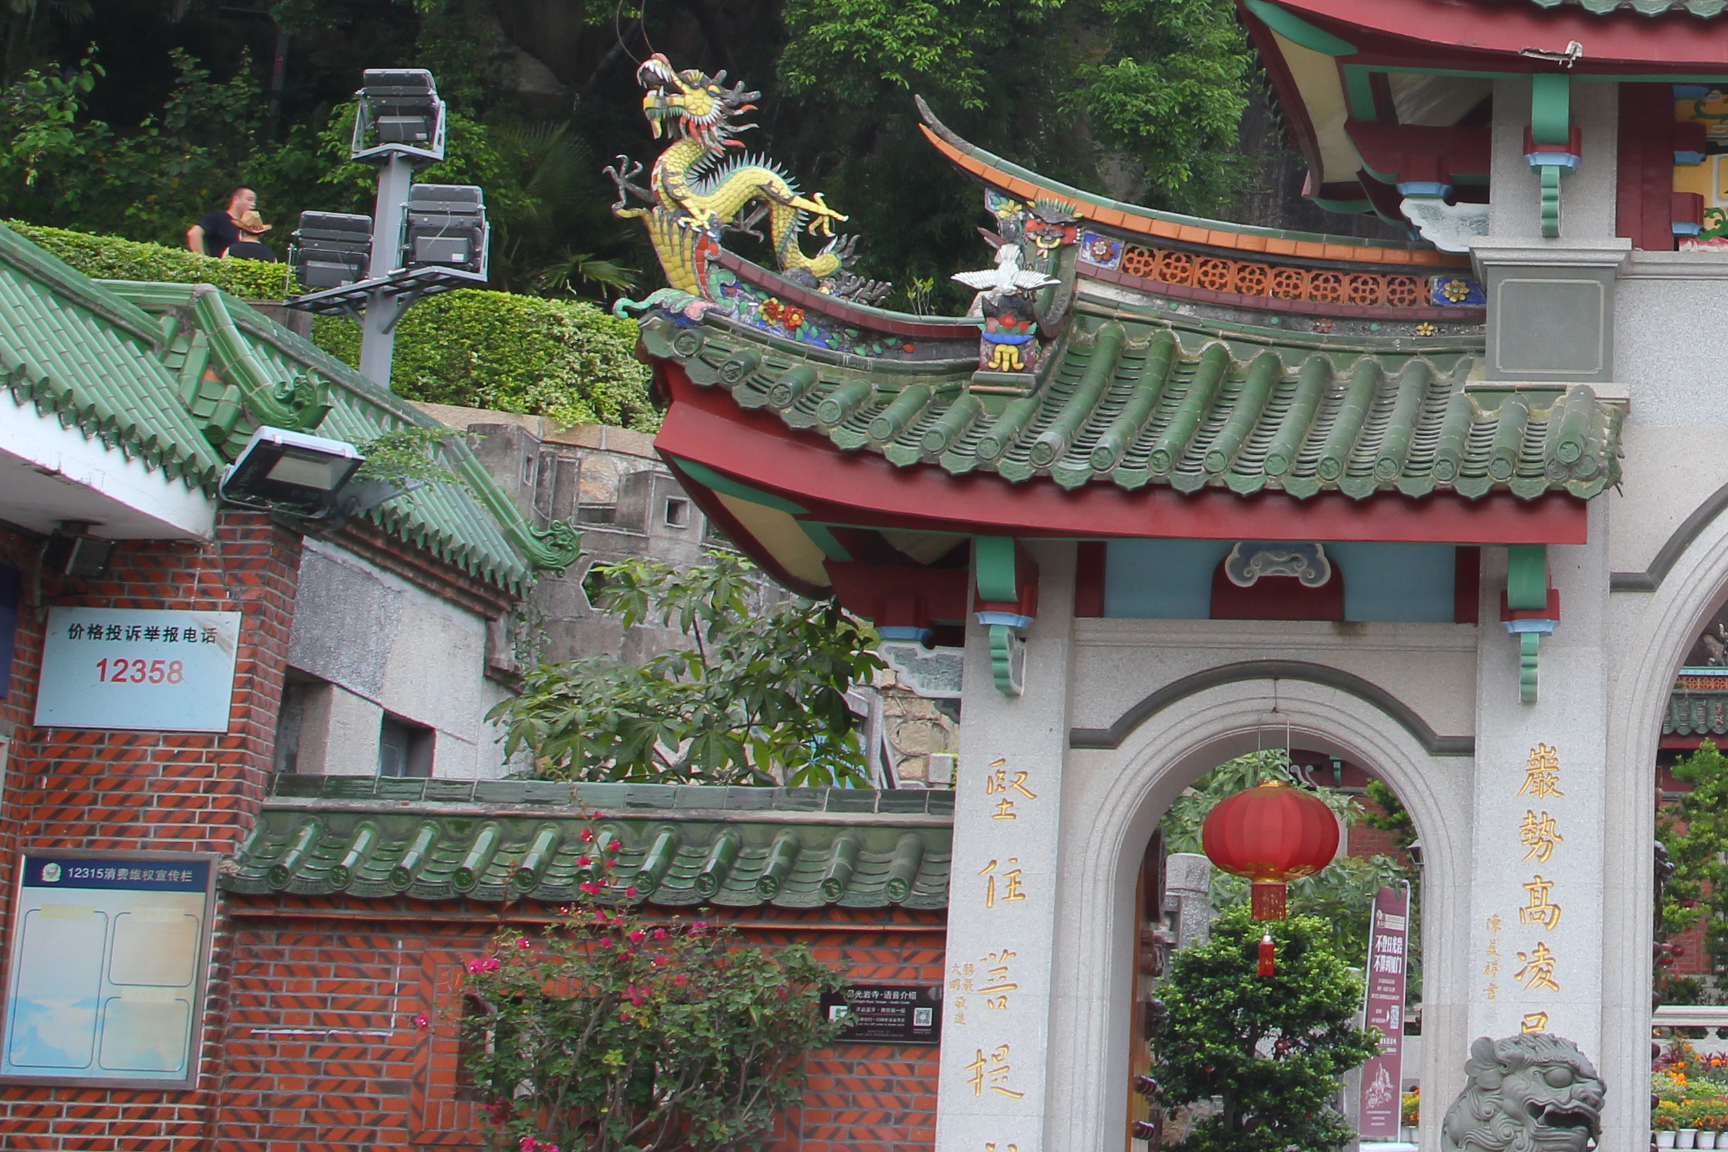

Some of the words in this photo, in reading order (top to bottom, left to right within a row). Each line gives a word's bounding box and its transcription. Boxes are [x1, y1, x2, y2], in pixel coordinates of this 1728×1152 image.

[68, 623, 218, 644] 价格投诉举报电话
[96, 658, 184, 684] 12358
[68, 867, 193, 882] 12315消费维权宣传栏
[963, 758, 1037, 1152] 堅住菩提
